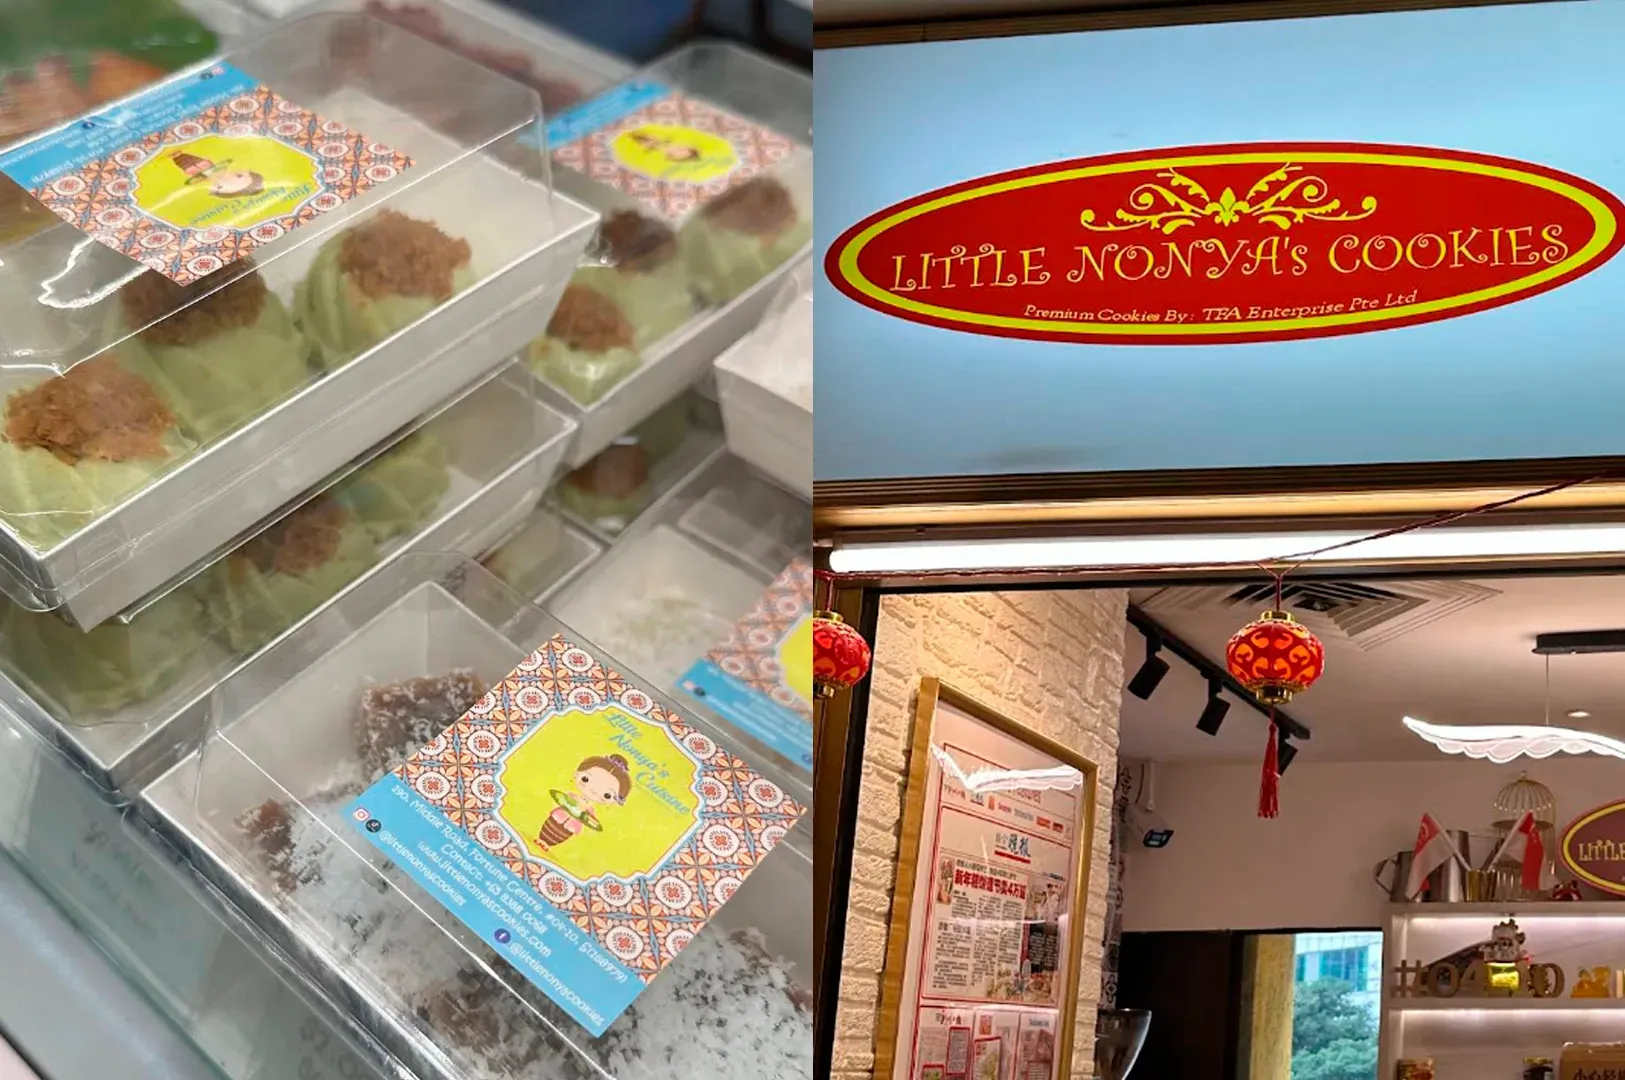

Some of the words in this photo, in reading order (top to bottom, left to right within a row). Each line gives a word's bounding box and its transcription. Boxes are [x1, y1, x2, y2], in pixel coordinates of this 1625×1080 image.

[889, 243, 1051, 292] LITTLE
[1328, 224, 1569, 274] COOKIES
[1024, 305, 1095, 321] Premium
[1098, 307, 1160, 322] Cookies
[1246, 301, 1345, 320] Enterprise
[1349, 297, 1380, 311] Pte
[1385, 289, 1418, 306] Ltd
[603, 712, 642, 739] Little
[608, 733, 670, 778] Nonya's
[636, 771, 690, 814] Cuisine
[410, 799, 443, 829] Middle
[468, 848, 508, 882] Fortune
